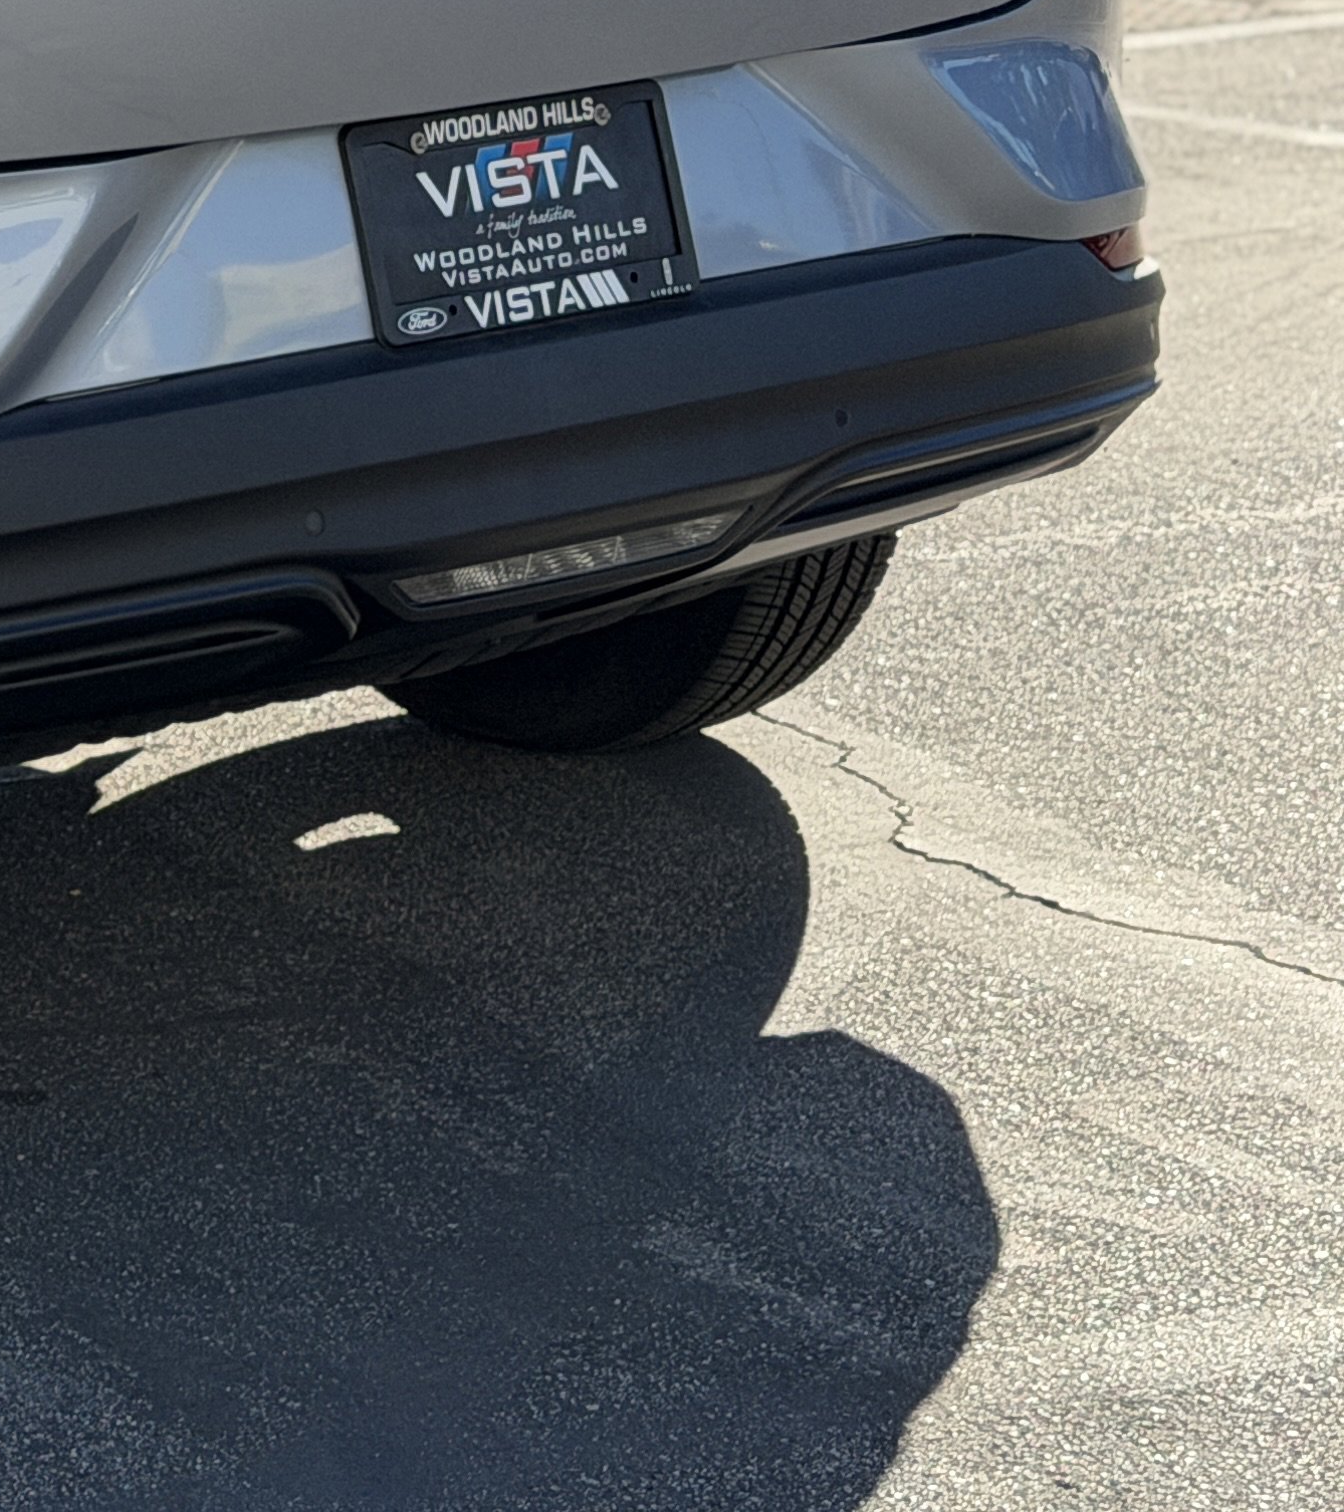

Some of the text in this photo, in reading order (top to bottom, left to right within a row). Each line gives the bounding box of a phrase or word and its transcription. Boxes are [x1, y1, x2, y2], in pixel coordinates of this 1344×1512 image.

[423, 96, 595, 146] WOODLAND HILLS
[415, 144, 619, 217] VISTA
[413, 216, 648, 273] WOODLAND HILLS
[463, 277, 587, 329] VISTA
